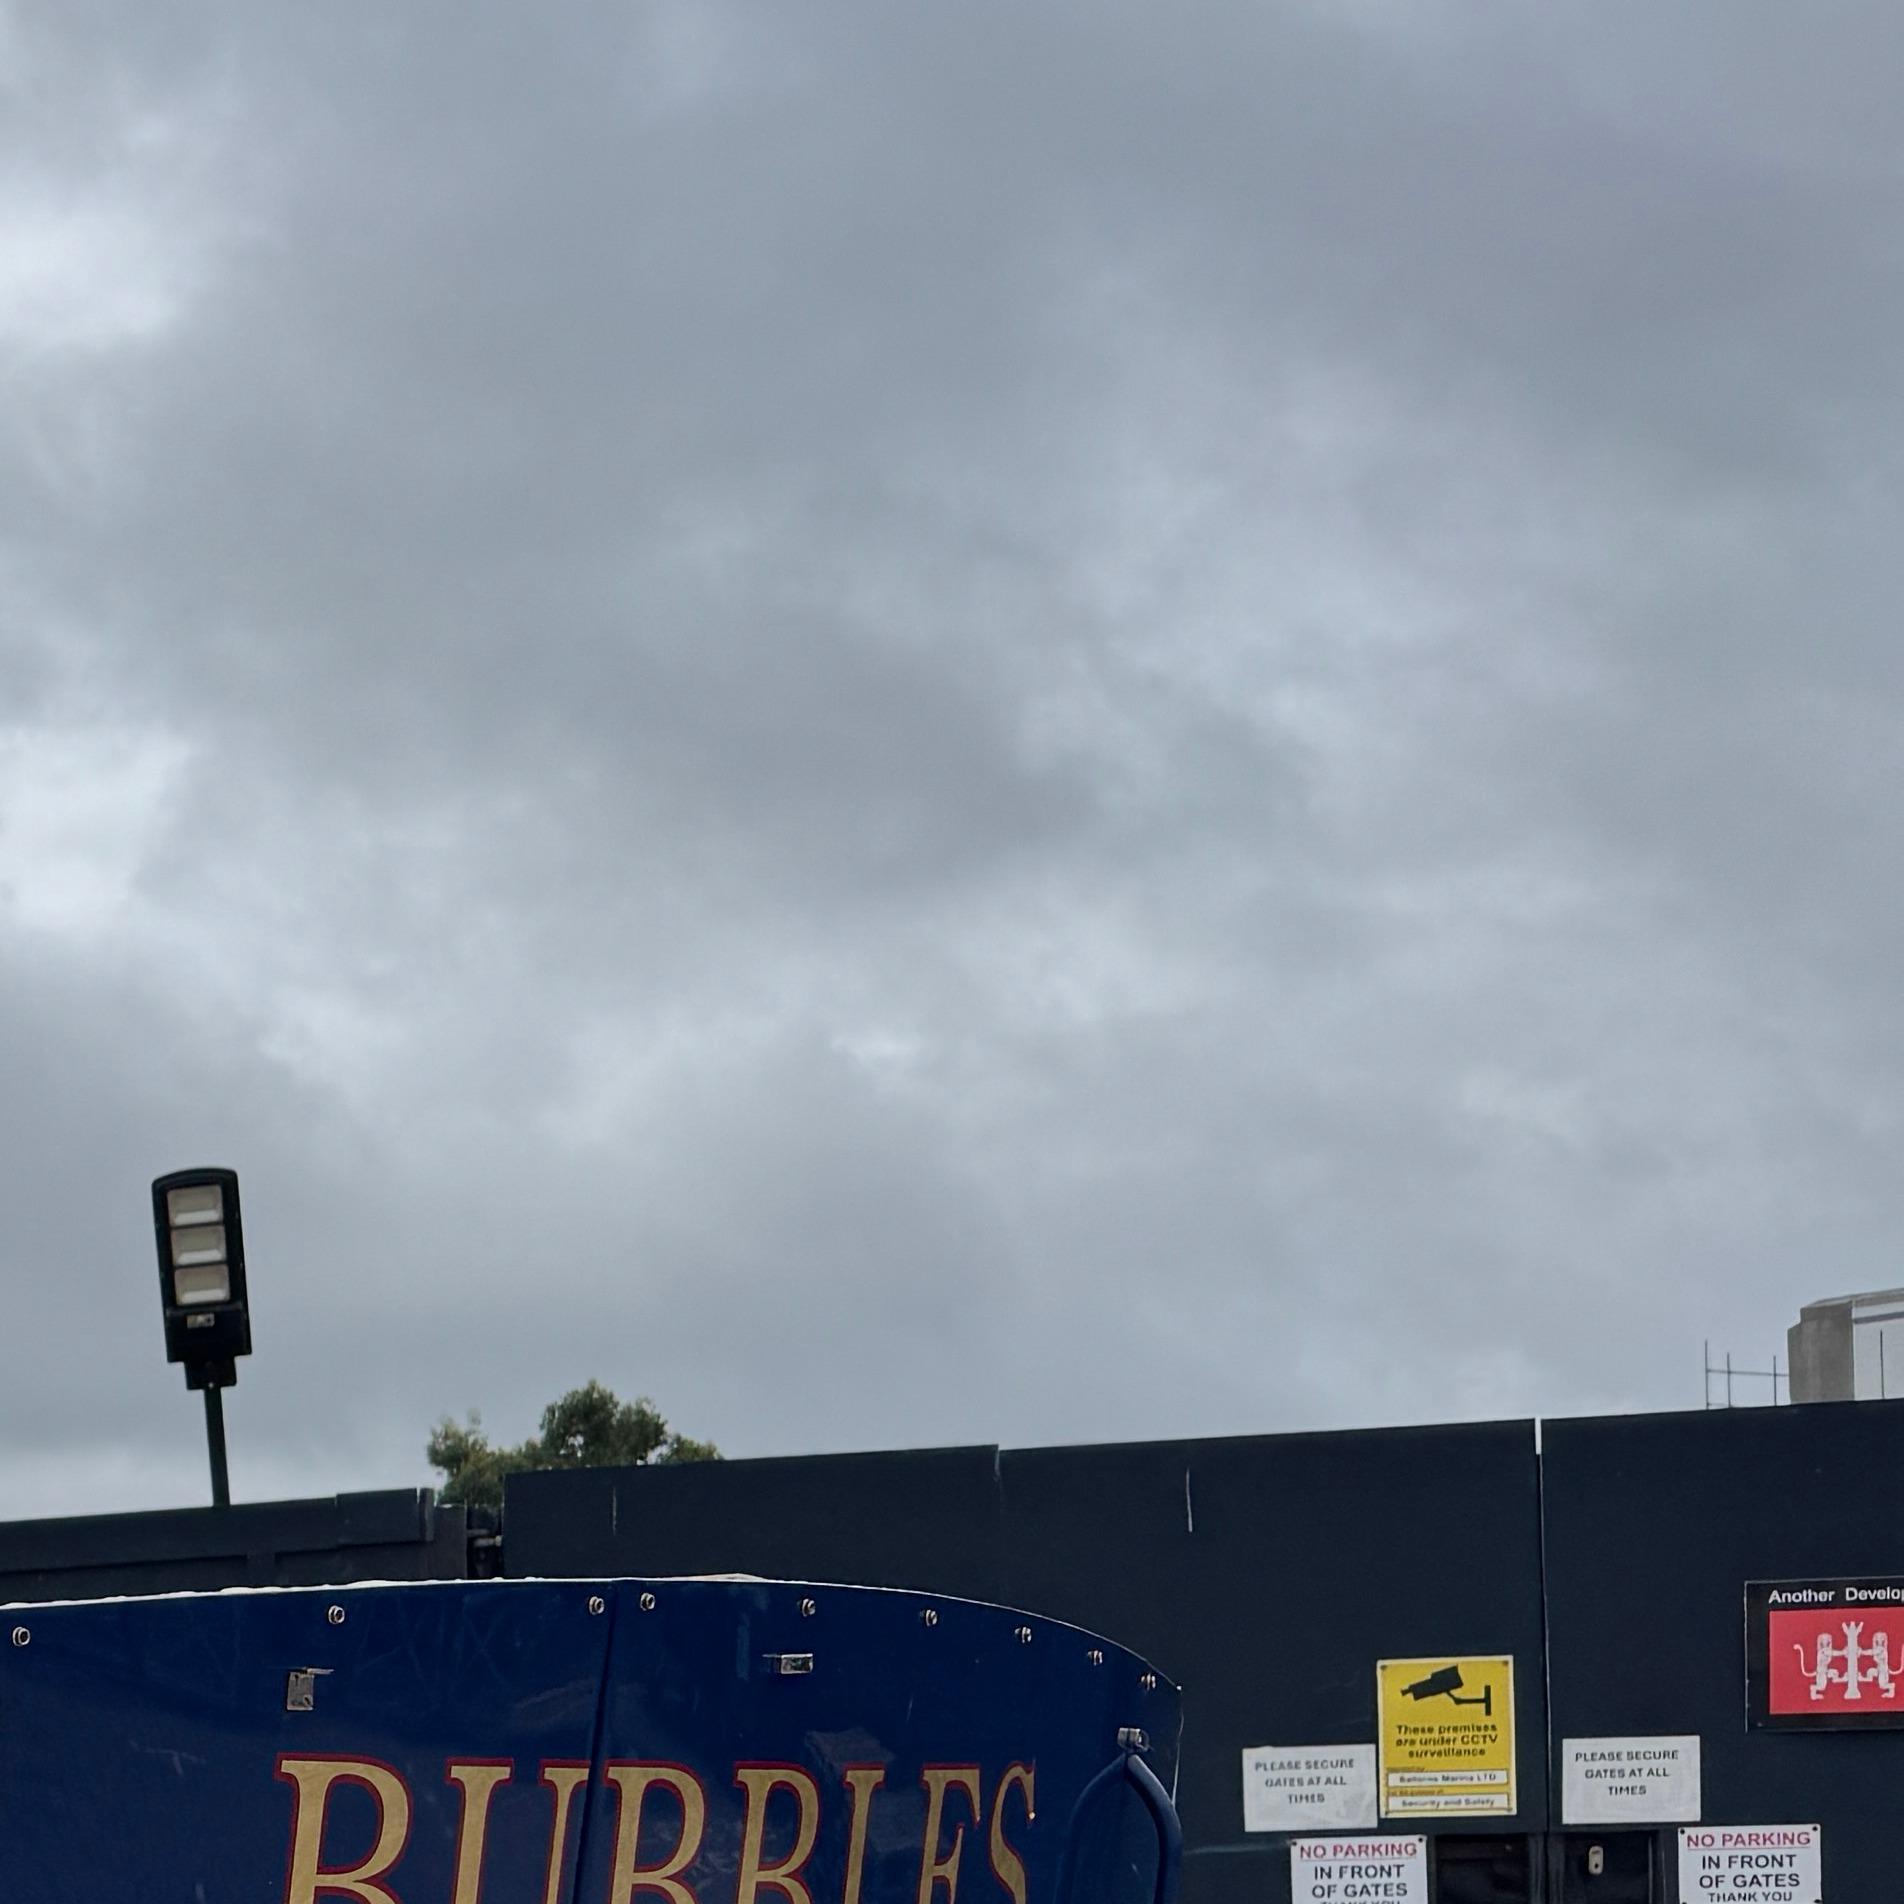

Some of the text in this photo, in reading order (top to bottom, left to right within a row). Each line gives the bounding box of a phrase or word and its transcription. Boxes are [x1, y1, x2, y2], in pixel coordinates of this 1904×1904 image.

[1768, 1586, 1904, 1604] Another Develo
[1396, 1723, 1497, 1735] These premises
[1419, 1736, 1457, 1746] under
[1460, 1733, 1498, 1746] CCTV
[1408, 1747, 1486, 1758] surveillance
[1574, 1749, 1679, 1762] PLEASE SECURE
[1254, 1758, 1355, 1772] PLEASE SECURE
[1584, 1767, 1670, 1779] GATES AT ALL
[1264, 1775, 1347, 1788] GATES AT ALL
[1607, 1784, 1647, 1796] TIMES
[1288, 1793, 1325, 1804] TIMES
[1686, 1831, 1811, 1848] NO PARKING
[1300, 1842, 1417, 1859] NO PARKING
[1701, 1853, 1797, 1870] IN FRONT
[1314, 1864, 1405, 1880] IN FRONT
[1698, 1873, 1800, 1889] OF GATES
[1311, 1882, 1408, 1899] OF GATES
[1707, 1891, 1792, 1903] THANK YOU
